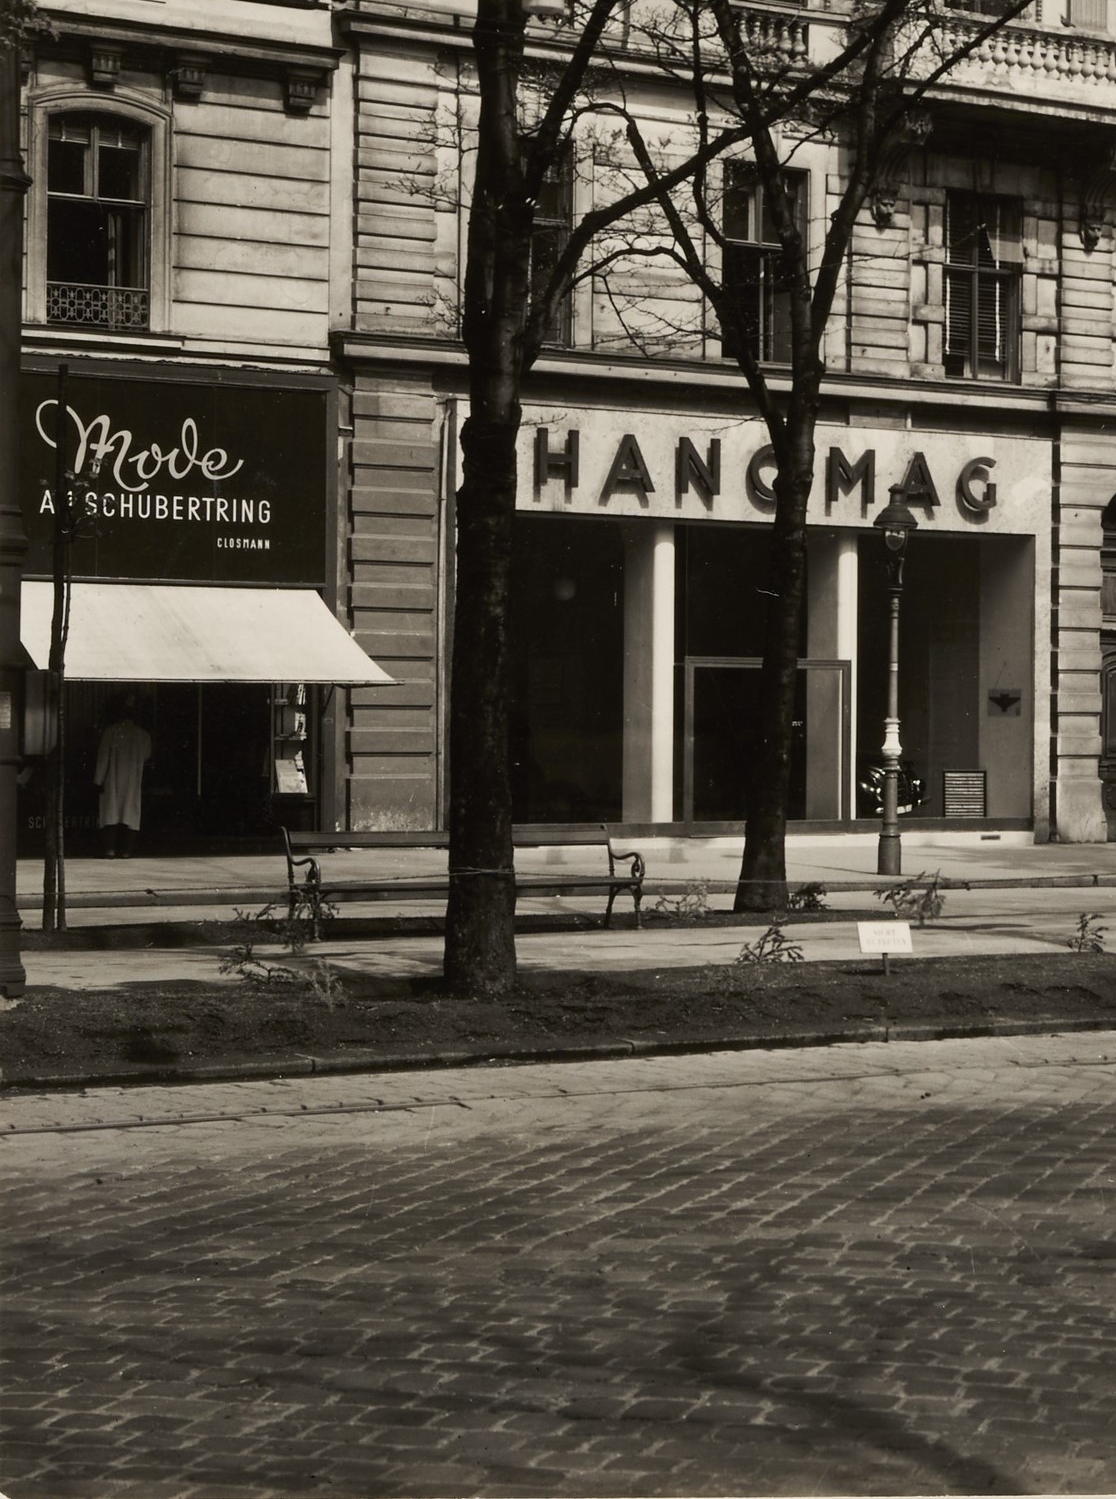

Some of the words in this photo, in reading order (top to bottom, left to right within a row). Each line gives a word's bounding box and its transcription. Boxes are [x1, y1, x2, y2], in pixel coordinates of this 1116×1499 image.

[36, 399, 244, 492] Mode
[85, 491, 272, 524] SCHUBERTRING
[216, 537, 271, 550] CLOSMANN
